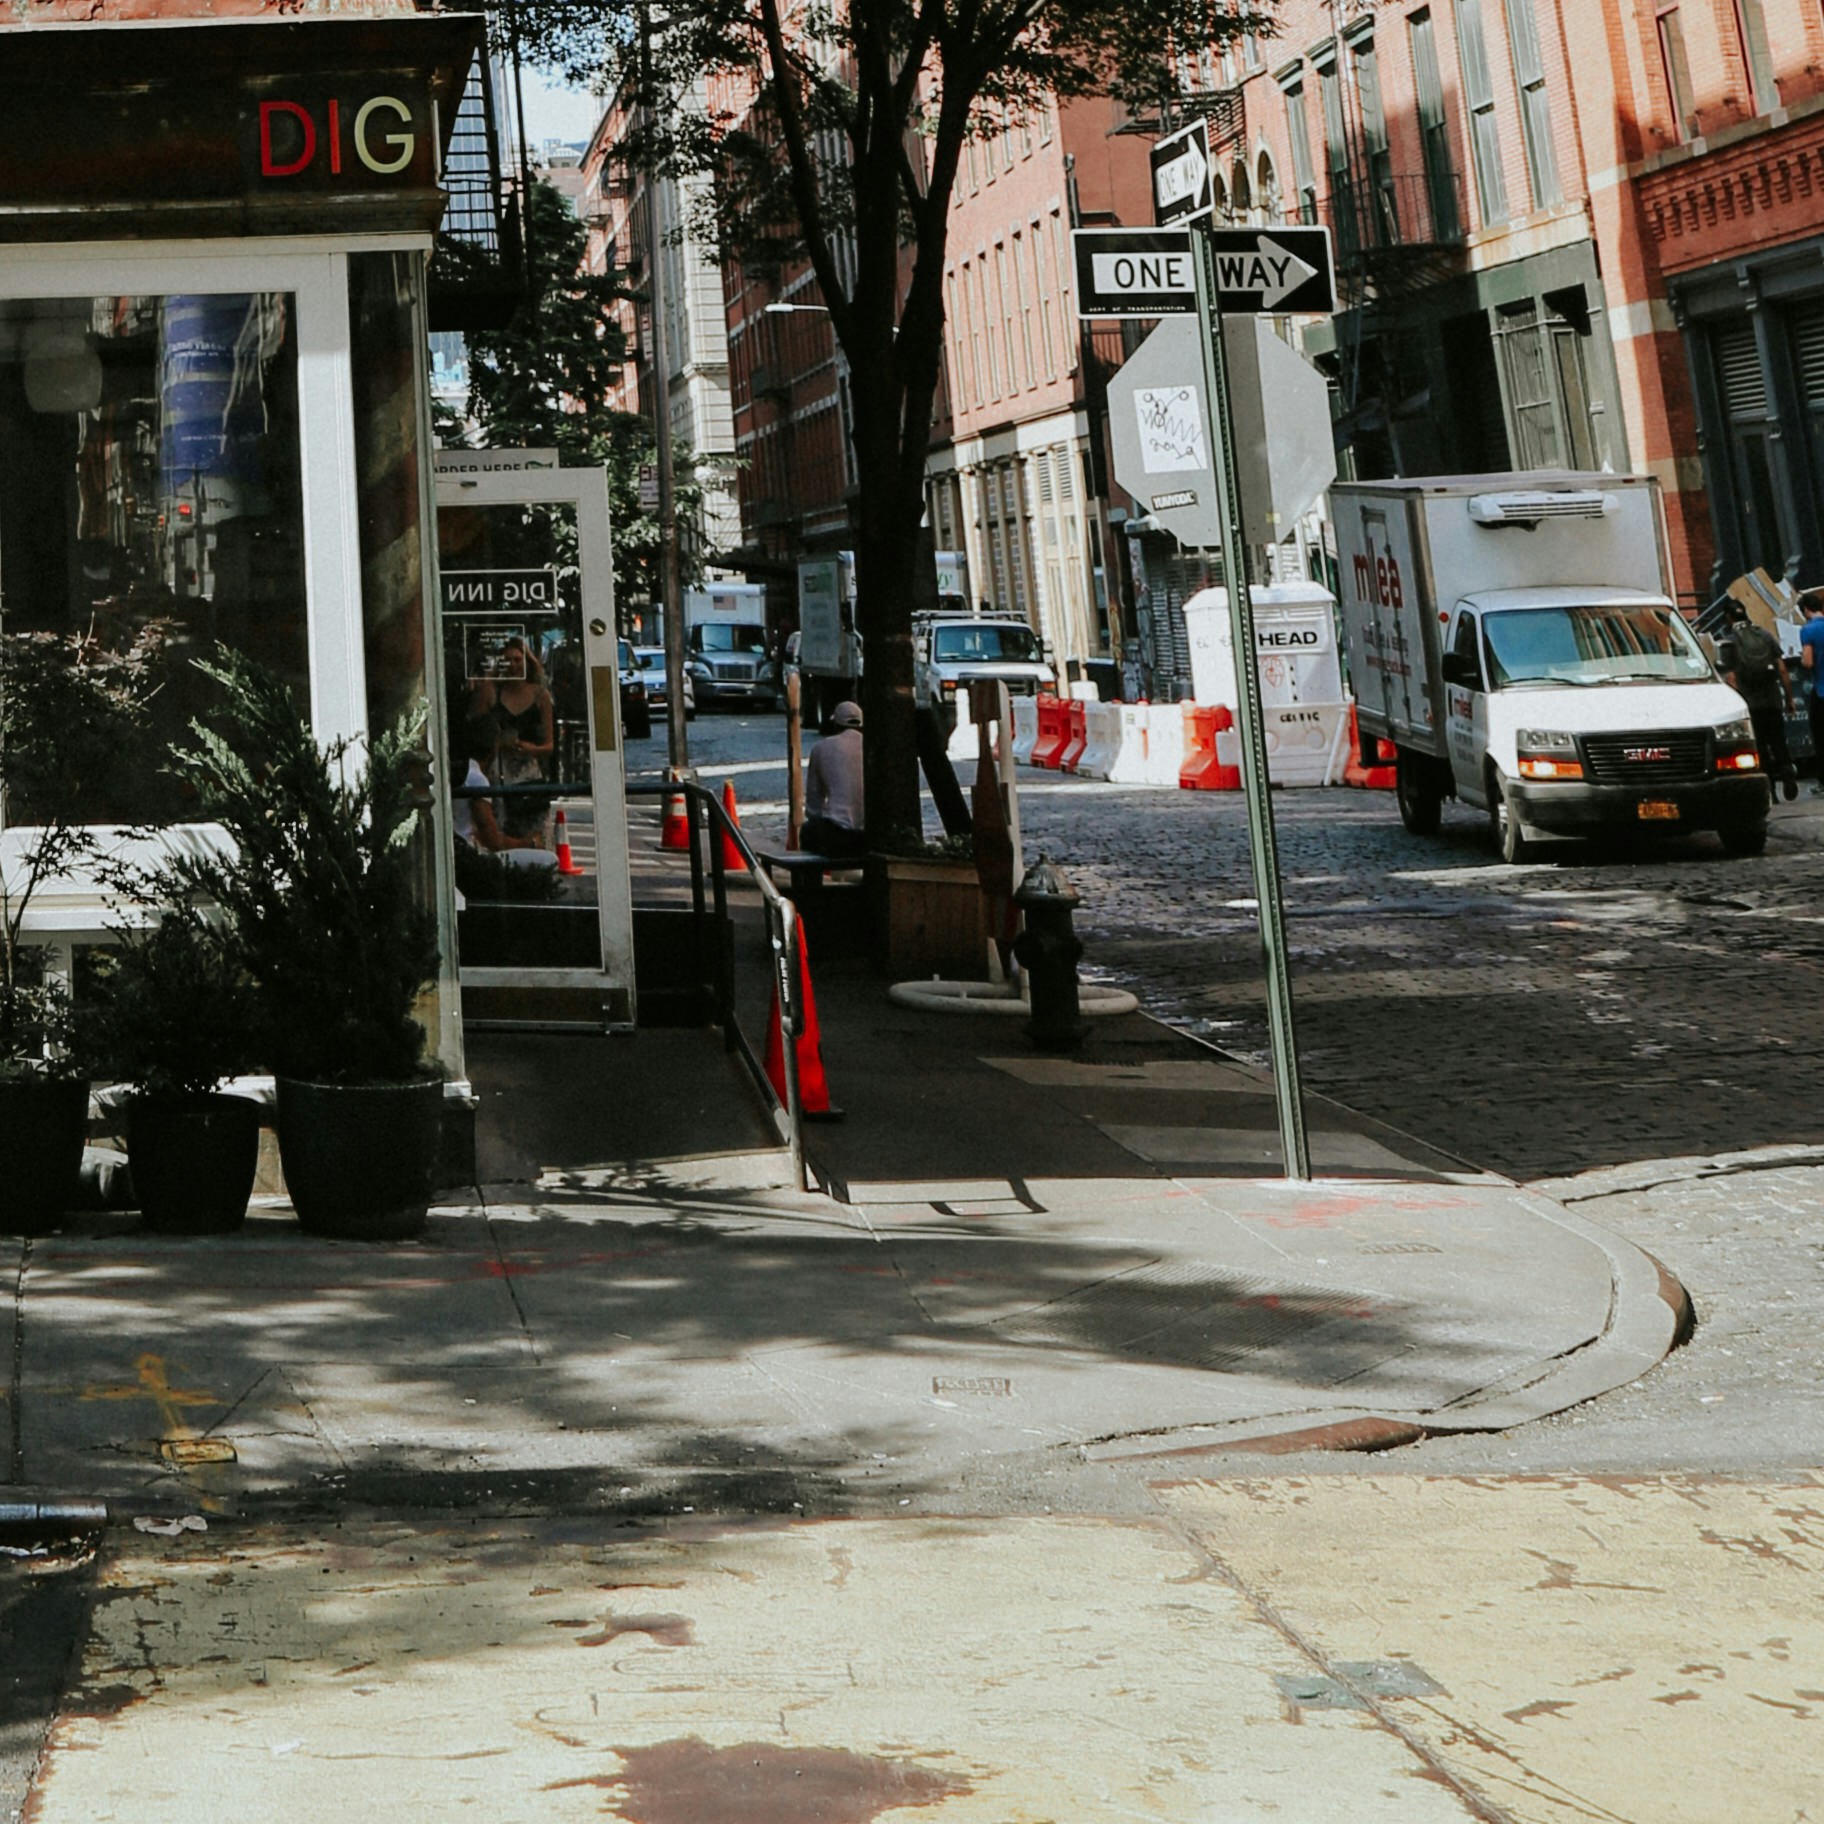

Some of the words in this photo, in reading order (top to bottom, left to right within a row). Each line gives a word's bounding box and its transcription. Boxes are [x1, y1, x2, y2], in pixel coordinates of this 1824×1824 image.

[259, 96, 415, 177] DIG
[1114, 258, 1186, 288] ONE
[1218, 256, 1292, 288] WAY
[433, 465, 479, 474] RDER
[1258, 631, 1318, 647] HEAD
[1279, 711, 1320, 723] CELTIC
